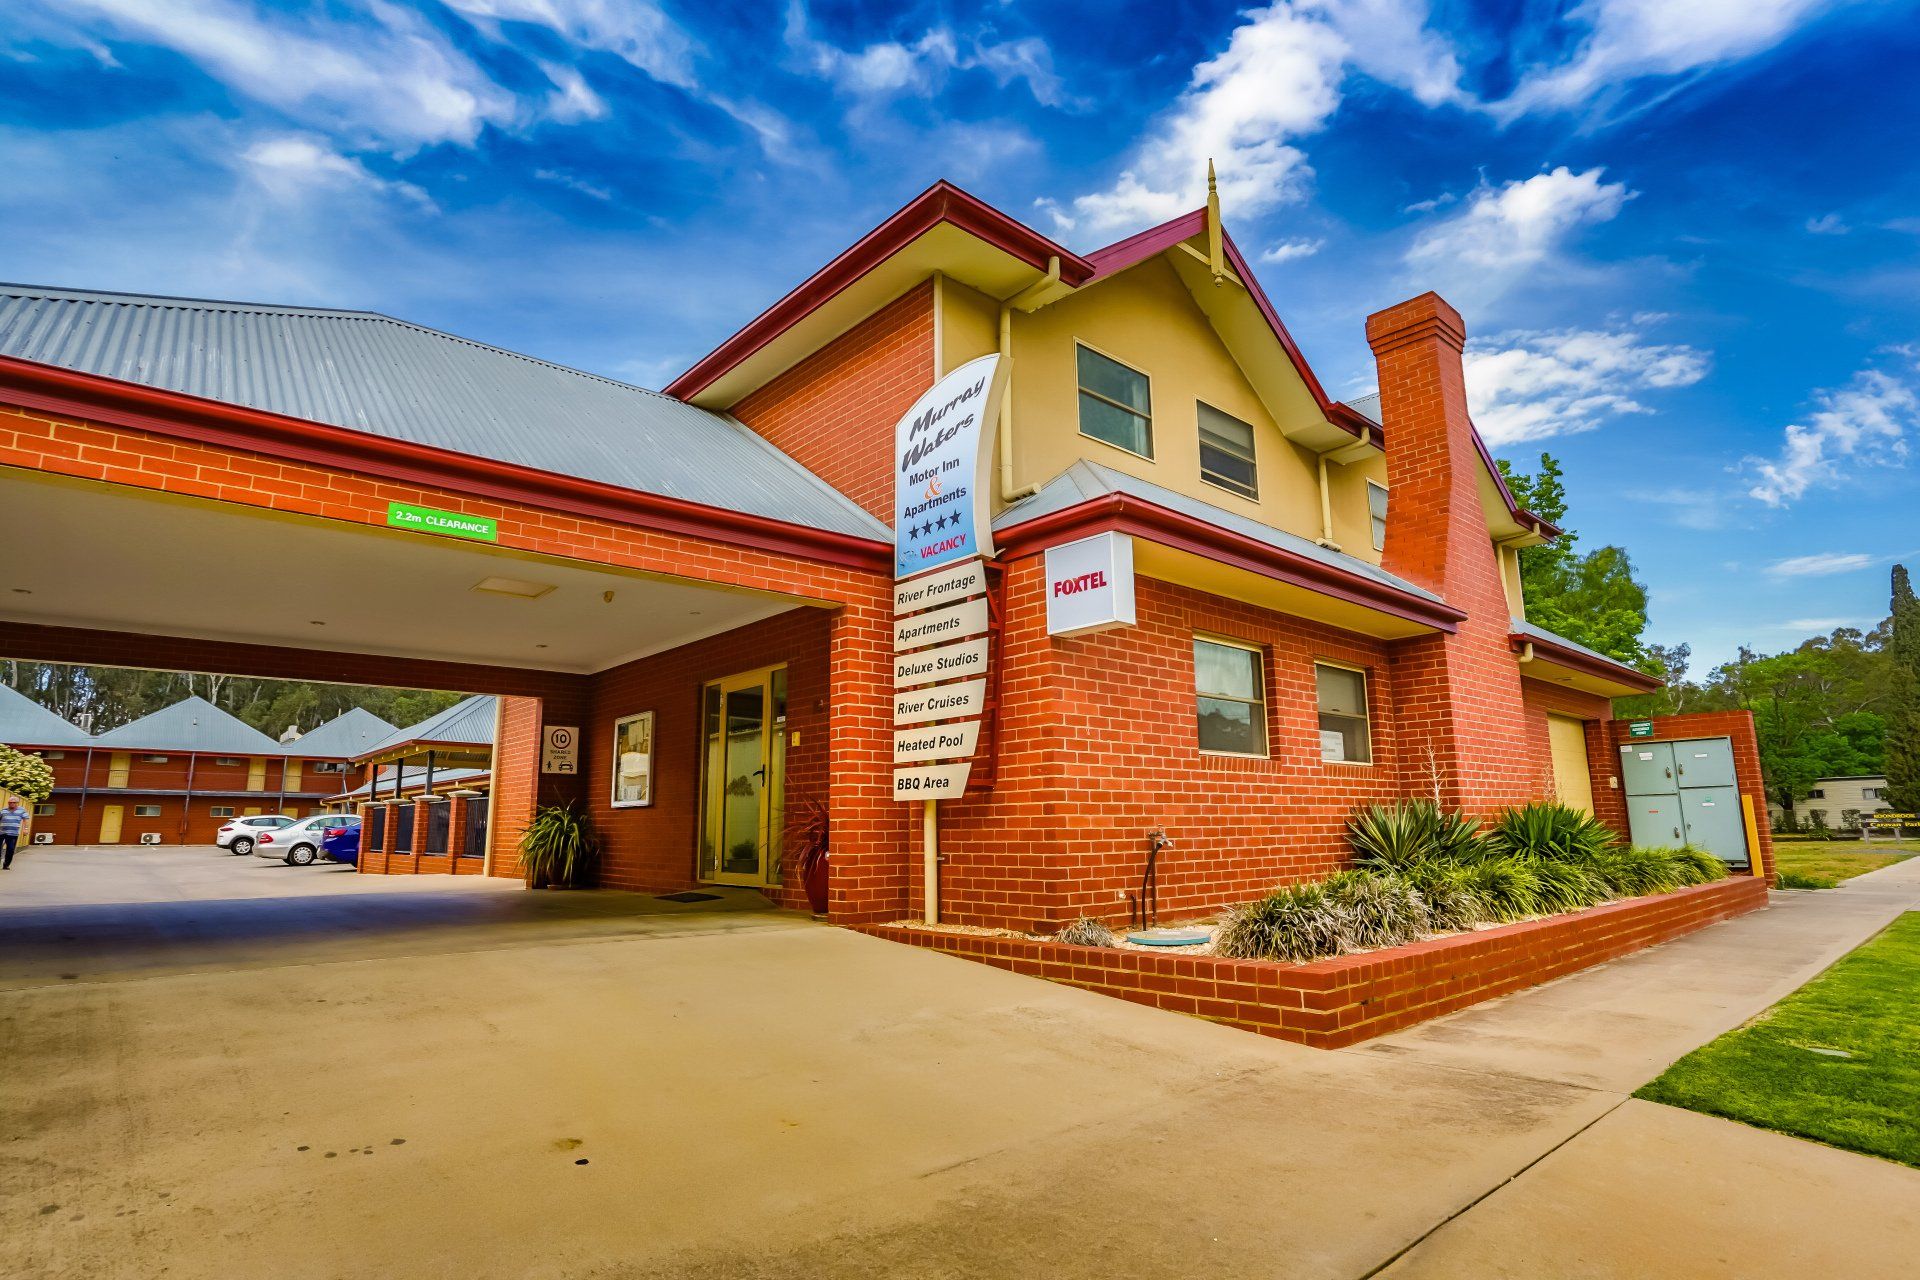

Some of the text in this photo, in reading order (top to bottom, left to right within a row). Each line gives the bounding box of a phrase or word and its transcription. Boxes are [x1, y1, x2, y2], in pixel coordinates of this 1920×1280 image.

[909, 375, 986, 442] Murray
[901, 413, 974, 472] Waters
[909, 458, 960, 487] Motor Inn
[924, 476, 942, 500] &
[904, 487, 967, 519] Apartments
[395, 510, 490, 534] 2.2m CLEARANCE
[920, 533, 967, 559] VACANCY
[897, 574, 976, 606] River Frontage
[1054, 570, 1108, 598] FOXTEL
[898, 617, 961, 642] Apartments
[897, 653, 979, 678] Deluxe Studios
[897, 694, 970, 715] River Cruises
[555, 733, 567, 744] 10
[897, 733, 964, 752] Heated Pool
[897, 776, 950, 790] BBQ Area
